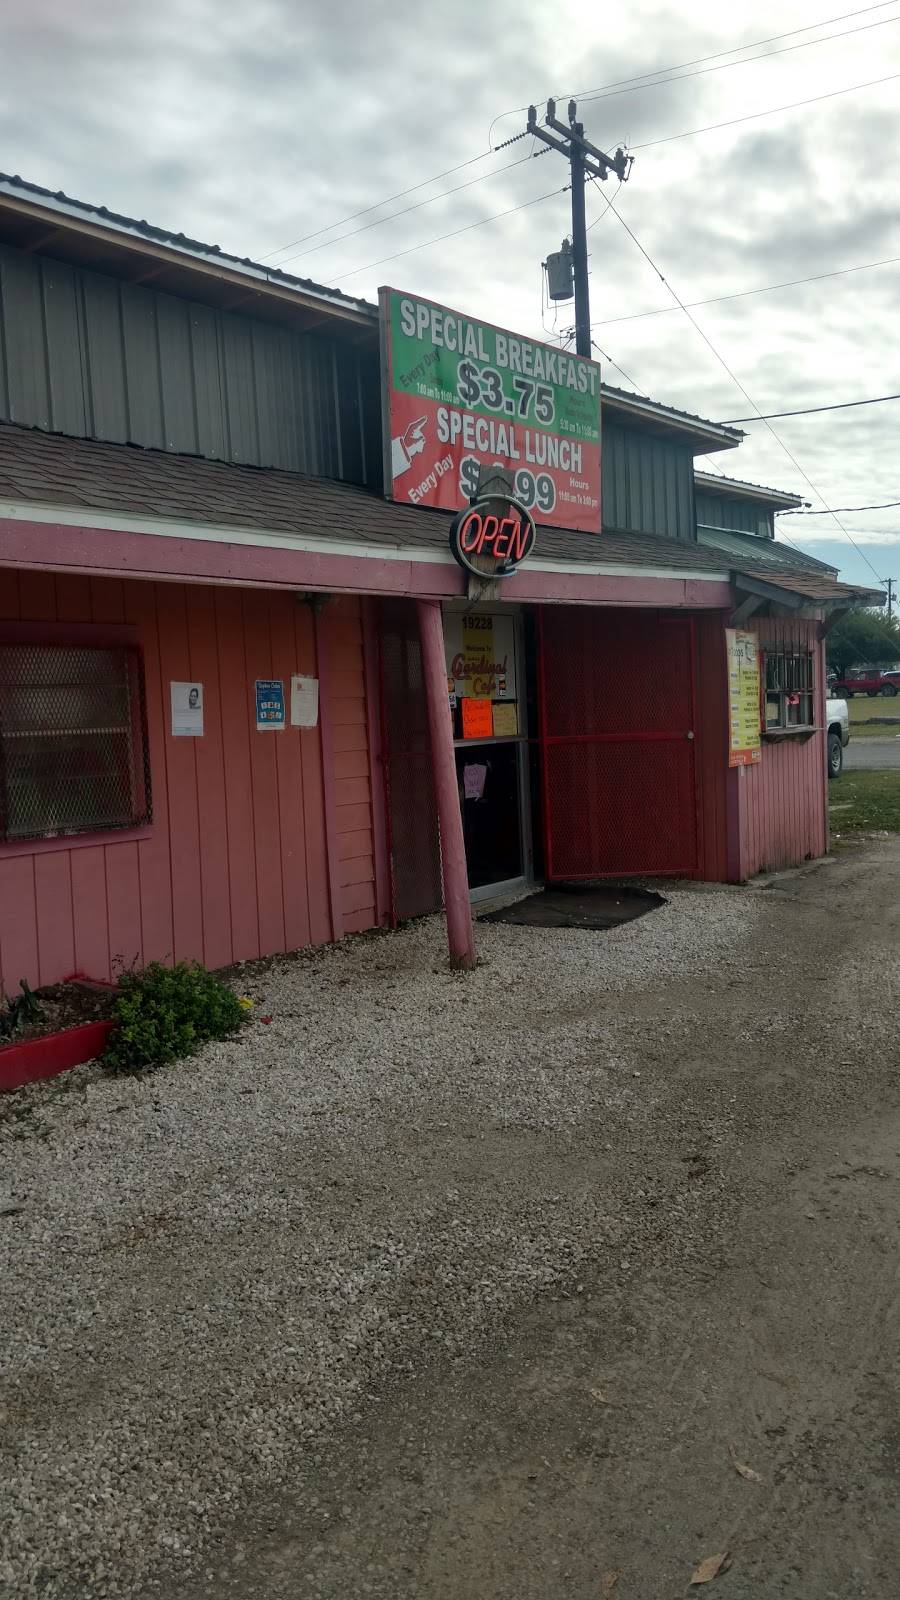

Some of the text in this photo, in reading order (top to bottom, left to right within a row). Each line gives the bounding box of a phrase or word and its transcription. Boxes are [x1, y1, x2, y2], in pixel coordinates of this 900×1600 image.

[400, 299, 599, 397] SPECIAL BREAKFAST
[457, 358, 557, 427] $3.75
[436, 407, 583, 474] SPECIAL LUNCH
[407, 453, 455, 505] Every Day
[569, 476, 590, 490] Hours
[461, 512, 531, 560] OPEN
[462, 615, 494, 630] 19228
[451, 652, 508, 680] Cardinal
